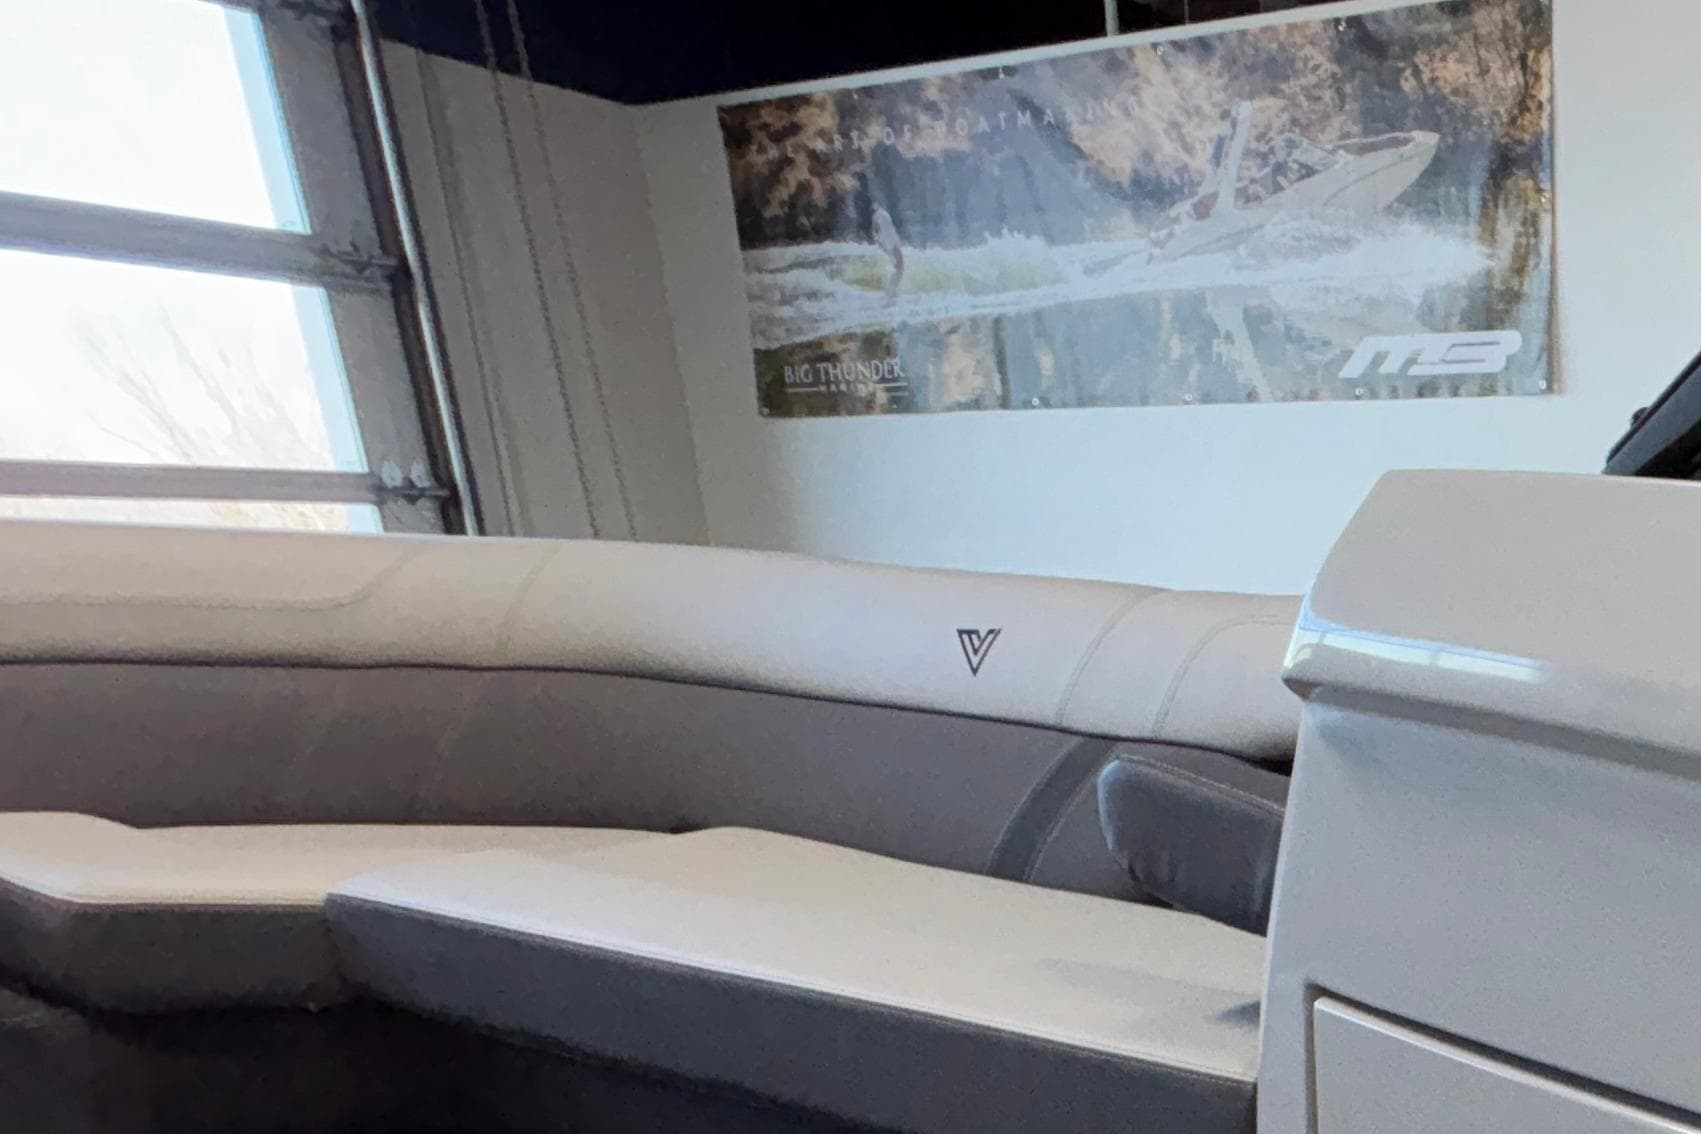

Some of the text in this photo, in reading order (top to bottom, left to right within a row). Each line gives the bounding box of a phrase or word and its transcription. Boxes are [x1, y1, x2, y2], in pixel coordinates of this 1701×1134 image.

[883, 124, 913, 147] OF
[784, 356, 906, 385] BIG THUNDER
